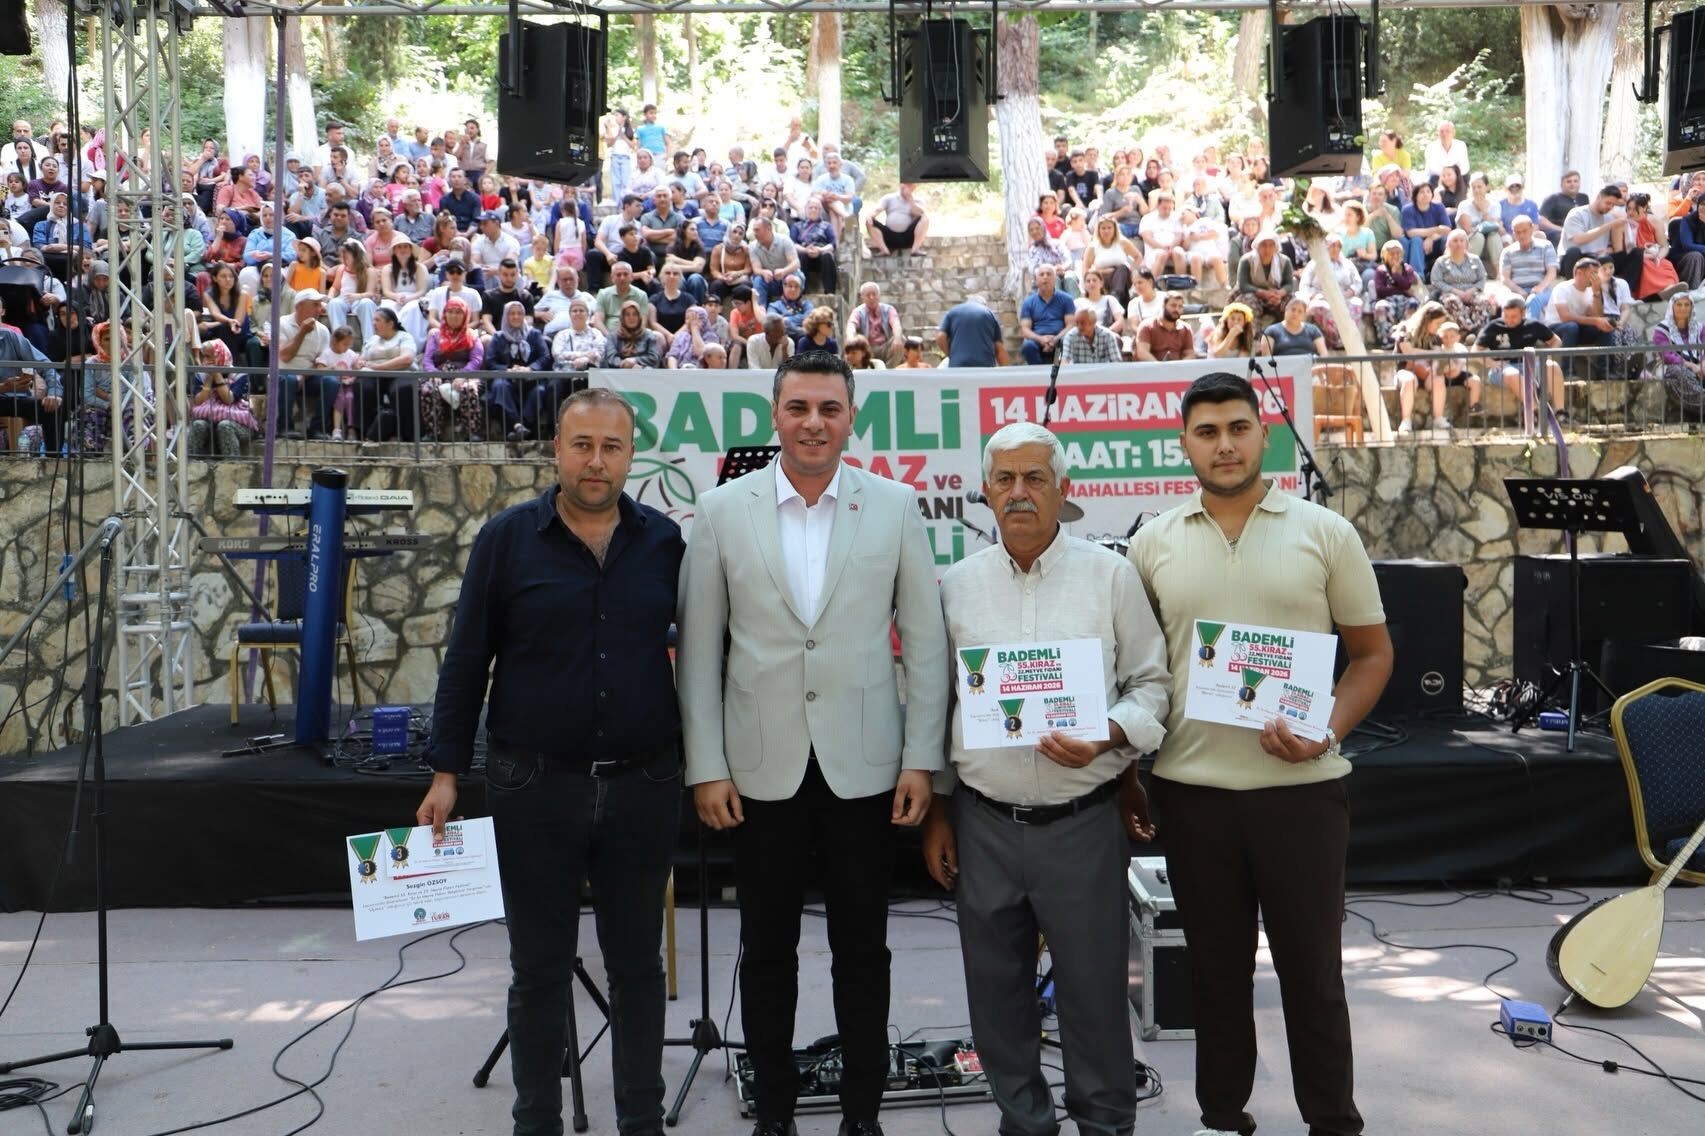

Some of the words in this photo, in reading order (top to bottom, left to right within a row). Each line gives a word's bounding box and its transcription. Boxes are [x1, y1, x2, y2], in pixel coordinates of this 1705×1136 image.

[990, 396, 1029, 425] 14
[617, 389, 961, 453] BADMLİ
[1064, 439, 1143, 471] AAT:
[934, 473, 963, 490] ve
[218, 539, 251, 549] KORG
[385, 538, 419, 546] KROSS
[973, 674, 979, 685] 2
[1010, 719, 1016, 730] 2
[396, 848, 402, 859] 3
[364, 862, 371, 874] 3
